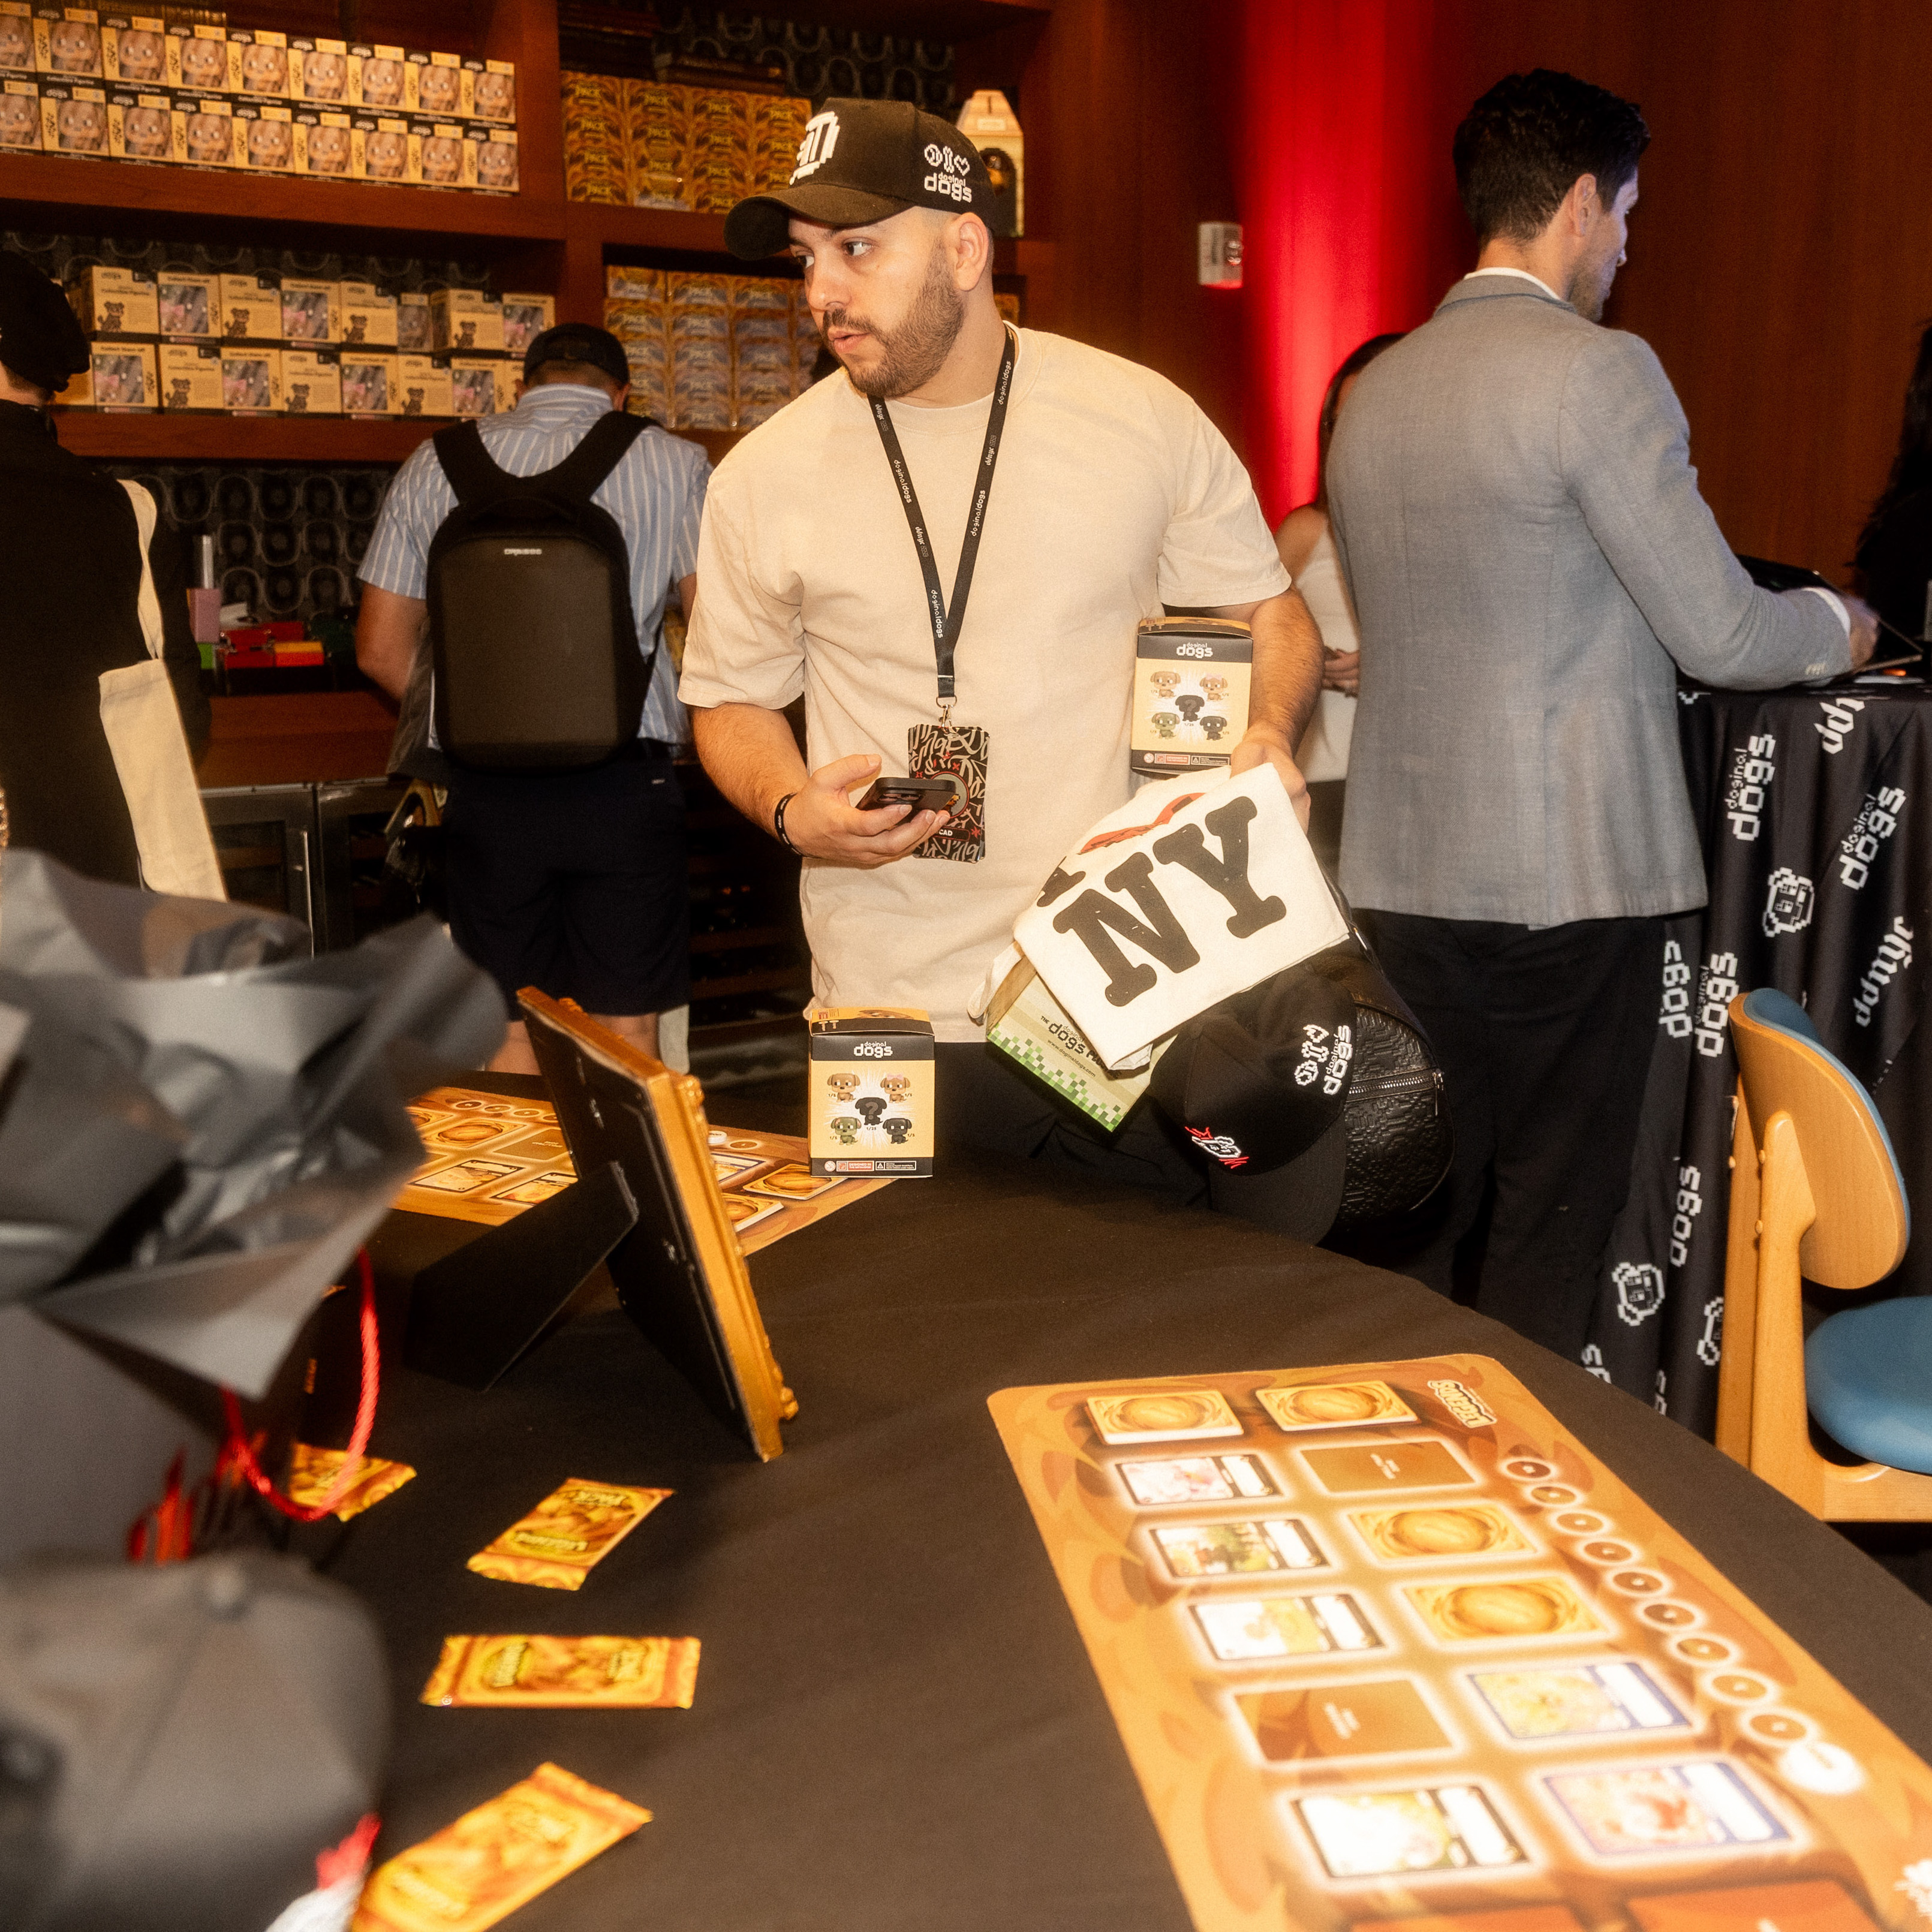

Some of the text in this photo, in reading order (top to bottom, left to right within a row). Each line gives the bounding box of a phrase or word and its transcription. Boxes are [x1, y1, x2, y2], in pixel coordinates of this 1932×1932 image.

[924, 172, 972, 203] dogs
[938, 171, 966, 187] doginal
[1176, 644, 1214, 659] dogs
[1723, 747, 1748, 809] doginal
[1726, 733, 1777, 841] dogs
[1838, 786, 1907, 890] dogs
[1840, 793, 1877, 854] doginal
[1052, 796, 1287, 1007] NY
[1694, 951, 1740, 1058] dogs
[853, 1043, 893, 1058] dogs
[1048, 1022, 1086, 1054] dogs
[1062, 1024, 1085, 1043] doginal
[1325, 1033, 1340, 1075] doginal
[1323, 1025, 1353, 1096] dogs
[1430, 1380, 1495, 1428] LEGENDS
